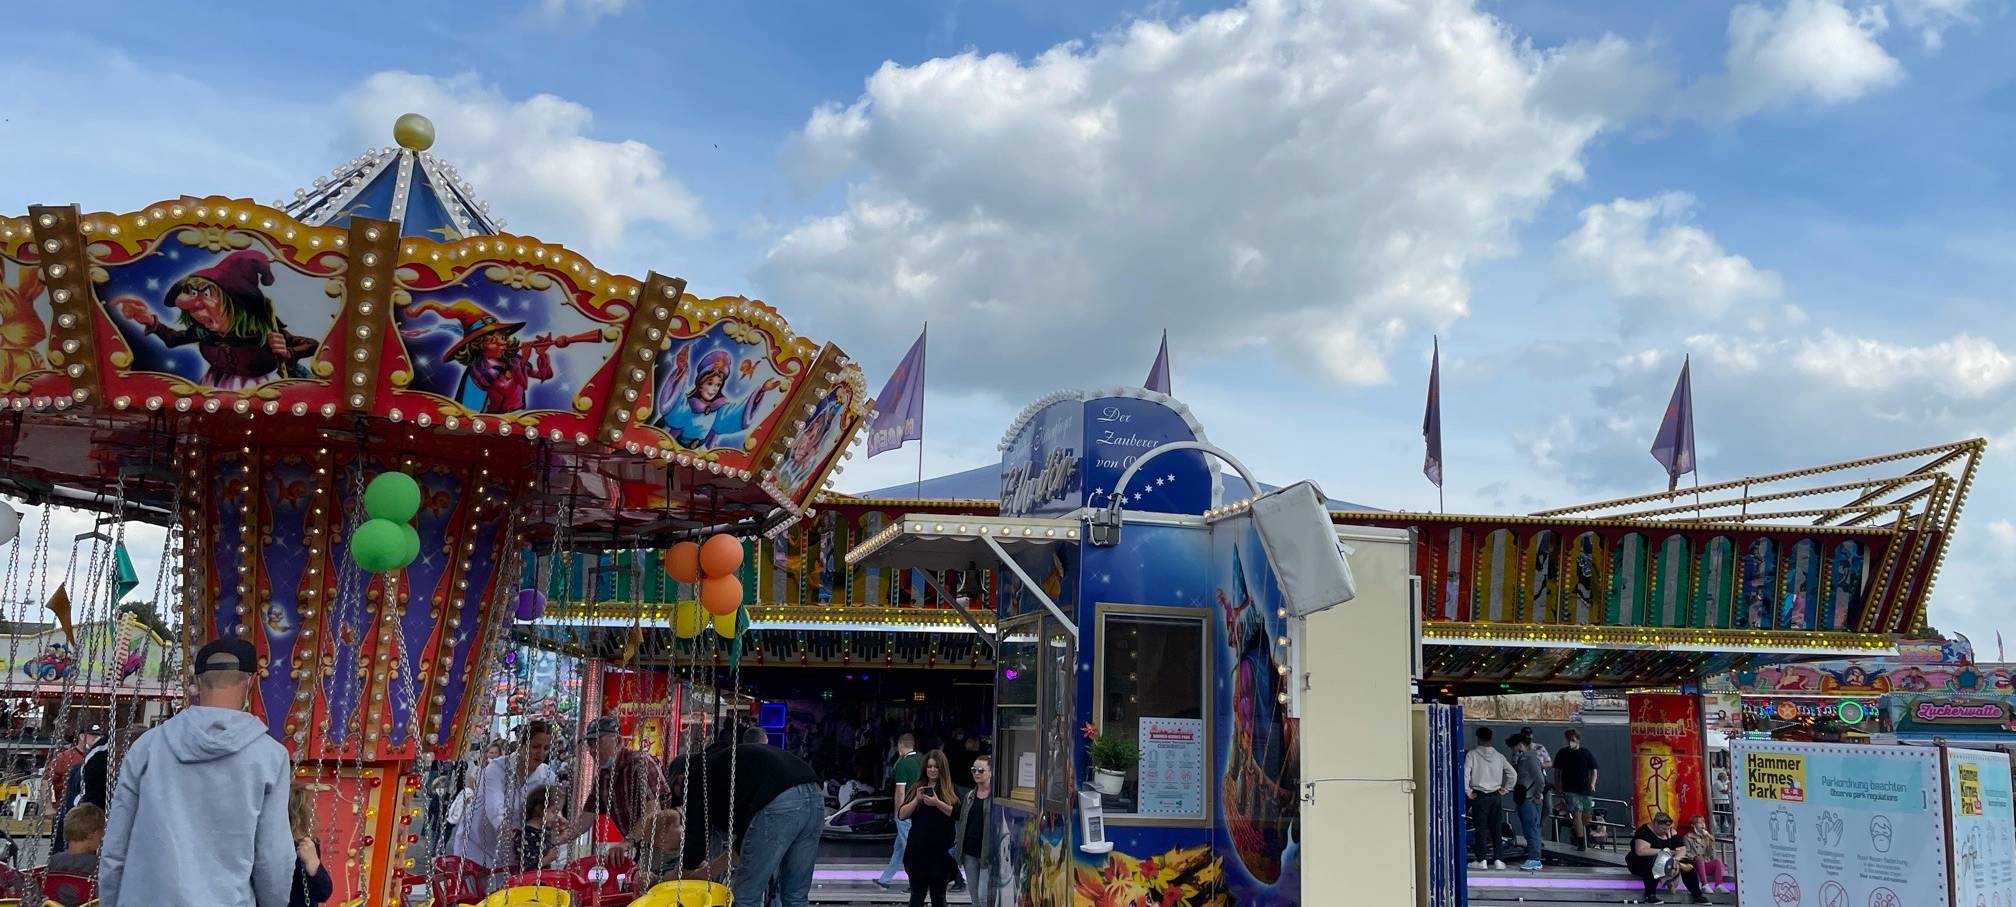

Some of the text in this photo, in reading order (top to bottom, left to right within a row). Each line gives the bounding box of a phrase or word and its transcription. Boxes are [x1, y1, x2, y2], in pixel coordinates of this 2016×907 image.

[1097, 406, 1131, 423] Der
[1096, 430, 1159, 448] Zauberer
[1096, 458, 1119, 469] von
[1917, 702, 2003, 720] Zuckerwatte
[1747, 753, 1801, 771] Hammer
[1748, 768, 1794, 786] Kirmes
[1748, 782, 1777, 800] Park
[1870, 780, 1907, 793] beachten
